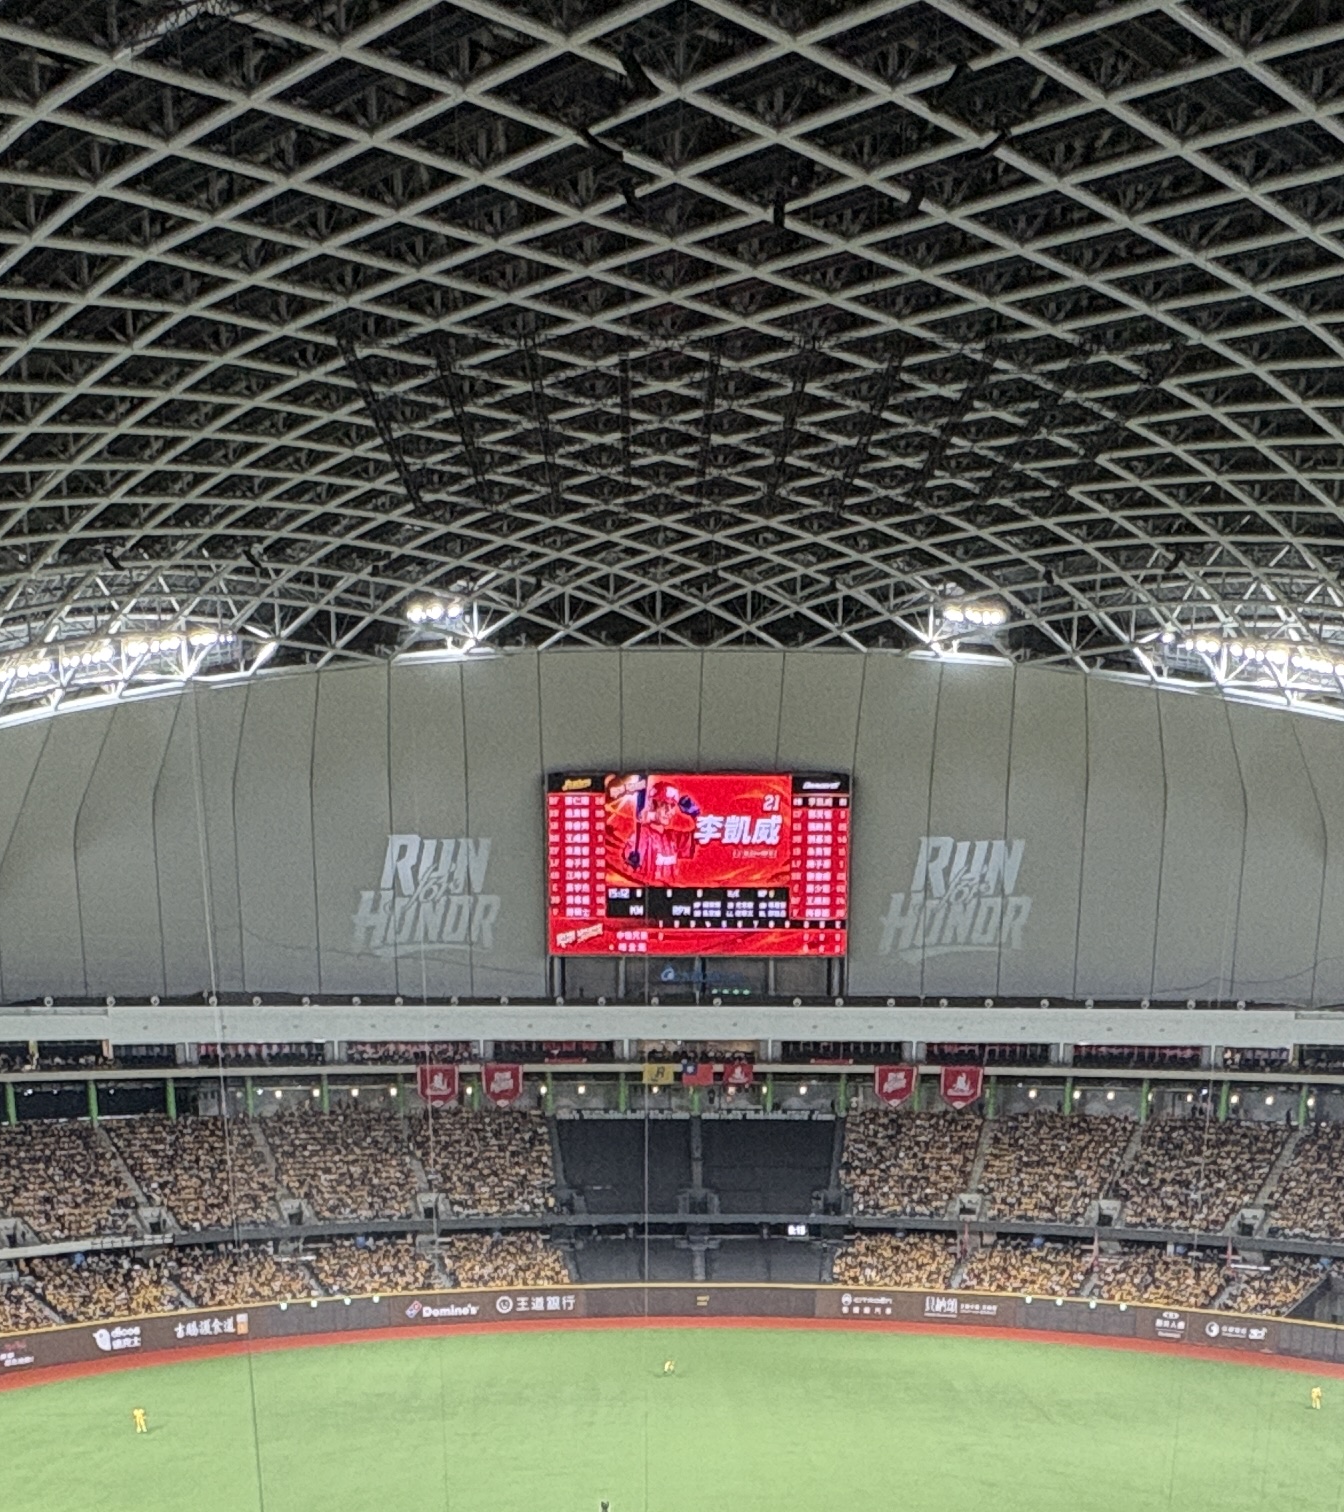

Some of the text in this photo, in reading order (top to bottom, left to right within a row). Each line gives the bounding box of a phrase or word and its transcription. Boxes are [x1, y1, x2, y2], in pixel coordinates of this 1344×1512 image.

[694, 814, 782, 844] 李凱威
[763, 794, 780, 811] 21
[381, 834, 492, 896] RUN
[911, 836, 1026, 898] RUN
[353, 890, 501, 951] HONOR
[879, 892, 1032, 955] HONOR
